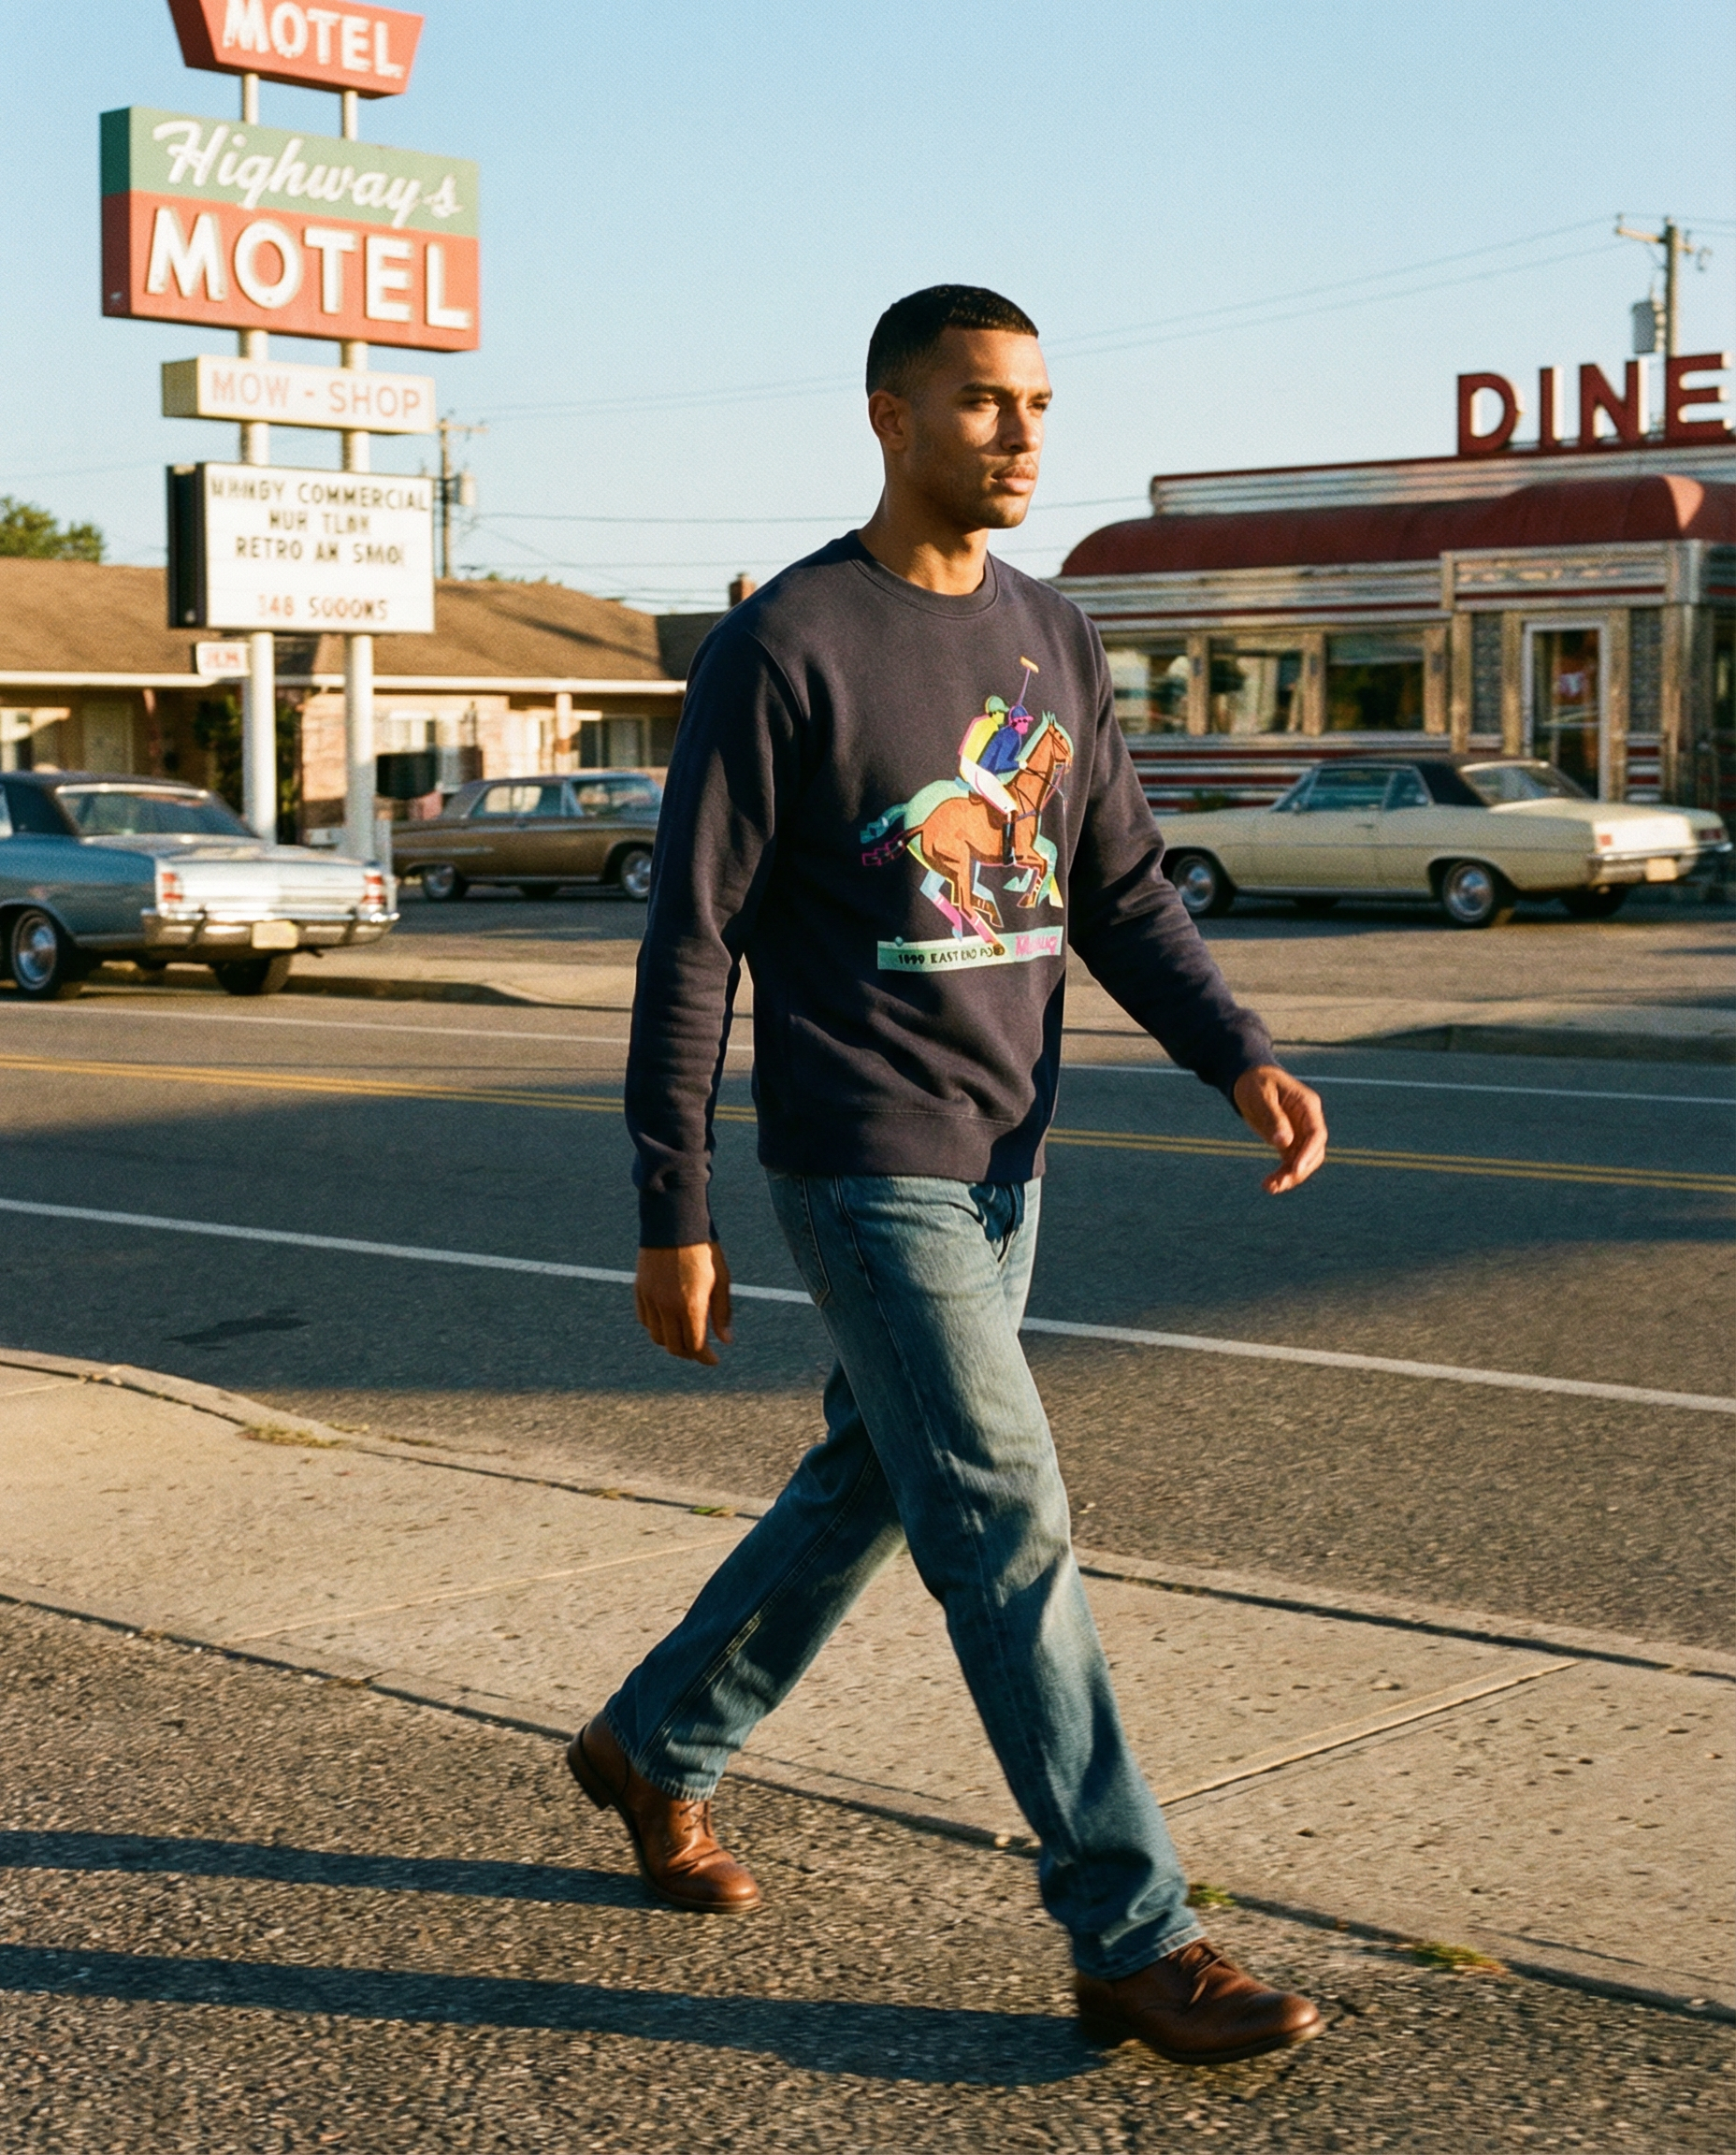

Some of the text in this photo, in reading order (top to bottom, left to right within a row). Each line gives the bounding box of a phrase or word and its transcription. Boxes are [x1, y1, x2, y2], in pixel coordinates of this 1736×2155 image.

[222, 0, 405, 79] MOTEL
[145, 205, 470, 331] MOTEL
[329, 381, 420, 418] SHOP
[1457, 352, 1736, 456] DINE
[298, 483, 428, 512] COMMERCIAL
[236, 535, 303, 560] RETRO
[931, 950, 959, 964] EAST
